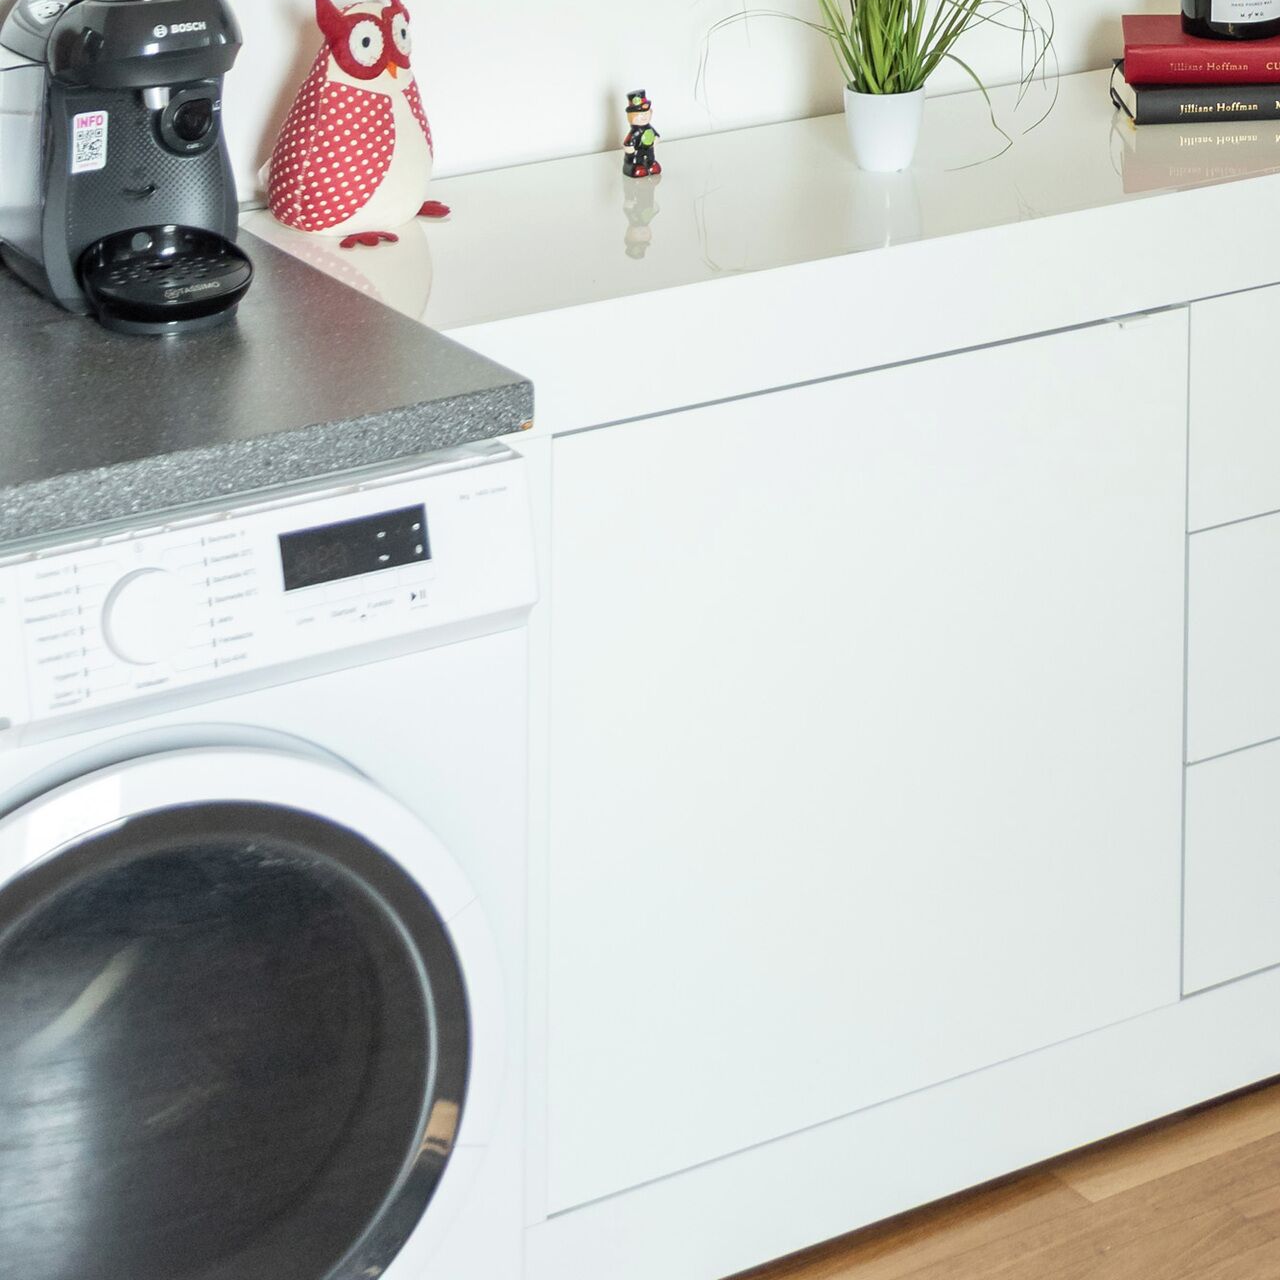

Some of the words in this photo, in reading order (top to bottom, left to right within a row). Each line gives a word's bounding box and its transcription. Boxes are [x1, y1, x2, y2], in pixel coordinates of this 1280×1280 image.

[170, 21, 207, 34] BOSCH
[1169, 62, 1203, 72] Jilliane
[1206, 61, 1249, 71] Hoffman
[1179, 104, 1213, 115] Jilliane
[1216, 101, 1259, 112] Hoffman
[76, 115, 104, 129] INFO
[179, 281, 221, 294] TASSIMO
